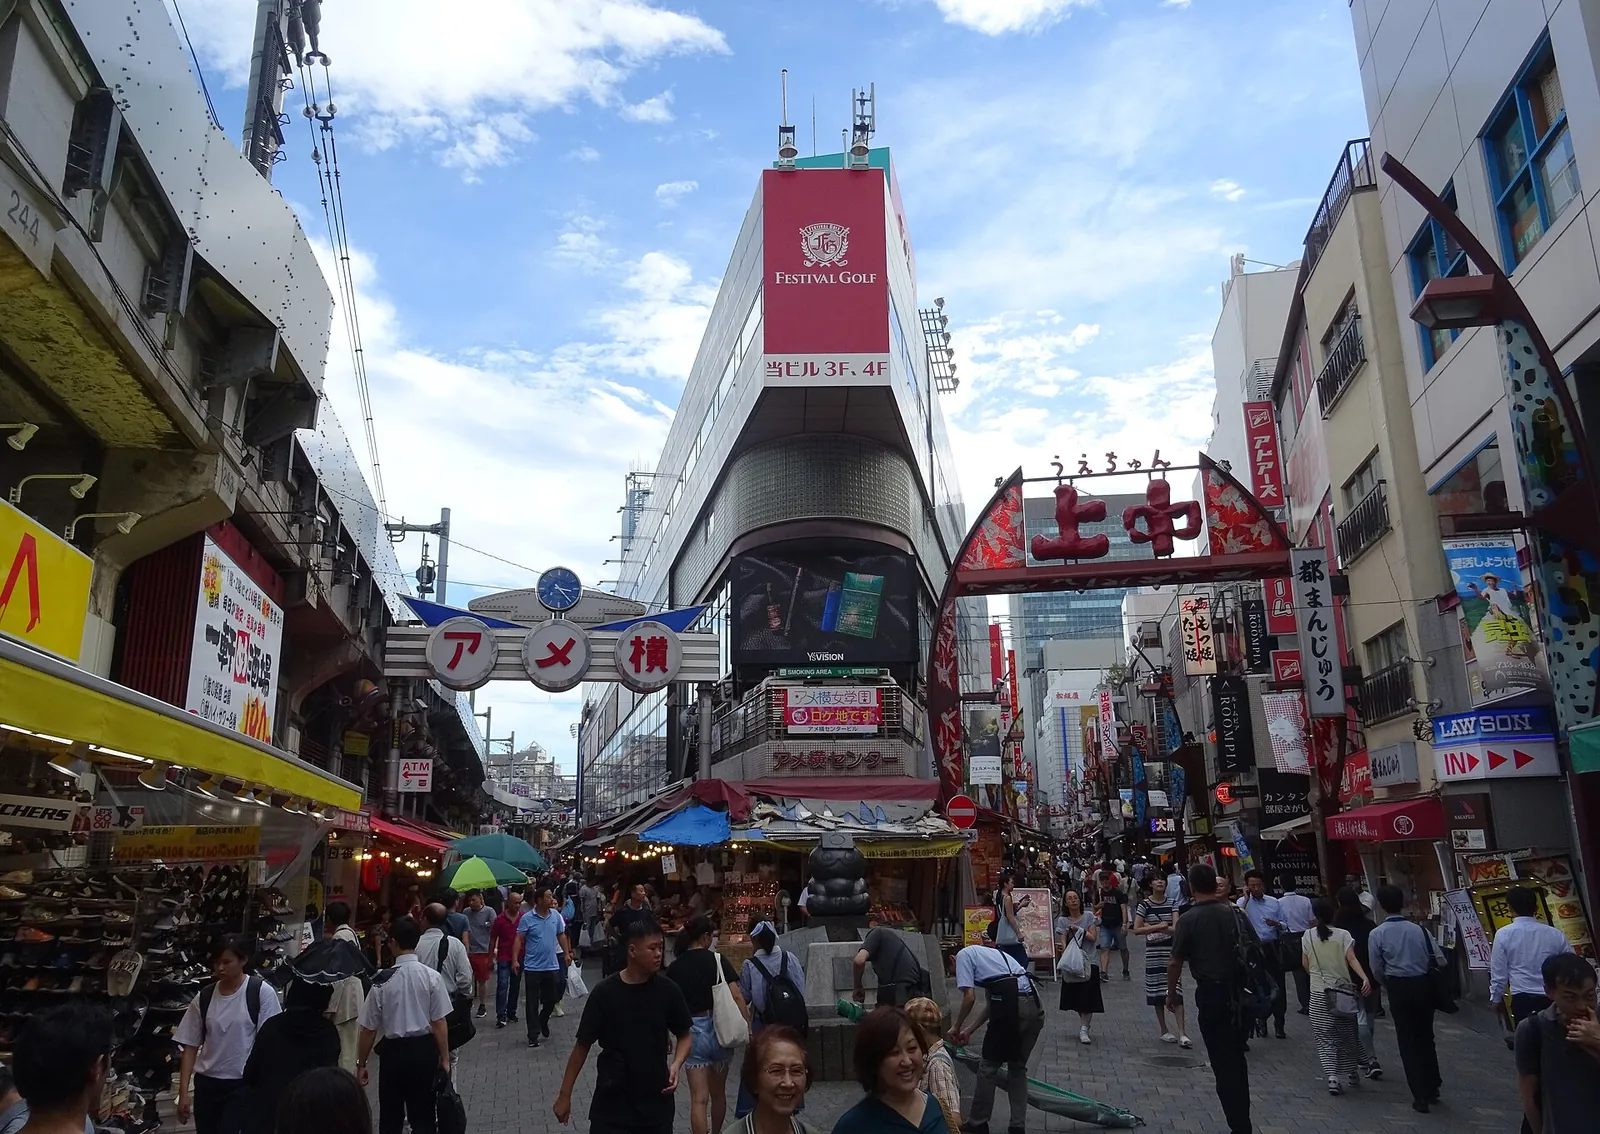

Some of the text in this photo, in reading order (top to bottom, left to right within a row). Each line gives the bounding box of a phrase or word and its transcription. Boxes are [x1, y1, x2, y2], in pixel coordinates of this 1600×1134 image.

[7, 189, 40, 247] 244
[775, 271, 877, 284] FESTIVAL GOLF
[766, 361, 888, 378] 当ビル3F、4F
[1050, 449, 1172, 475] うえちゅん
[1253, 435, 1278, 499] アドアーズ
[1031, 478, 1203, 561] 上中
[1298, 559, 1335, 702] 都まんじゅう
[443, 631, 669, 675] アメ横
[794, 690, 872, 705] アメ横女学園
[811, 710, 871, 722] ロケ地です
[1439, 713, 1532, 738] LAWSON
[1220, 696, 1236, 769] ROOMPIA
[402, 762, 430, 771] ATM
[773, 750, 898, 770] アメ横センター
[1444, 752, 1467, 775] IN
[1264, 793, 1308, 802] カンタン
[0, 802, 72, 822] CHERS
[1265, 805, 1309, 814] 部屋さがし
[93, 821, 112, 829] OUT
